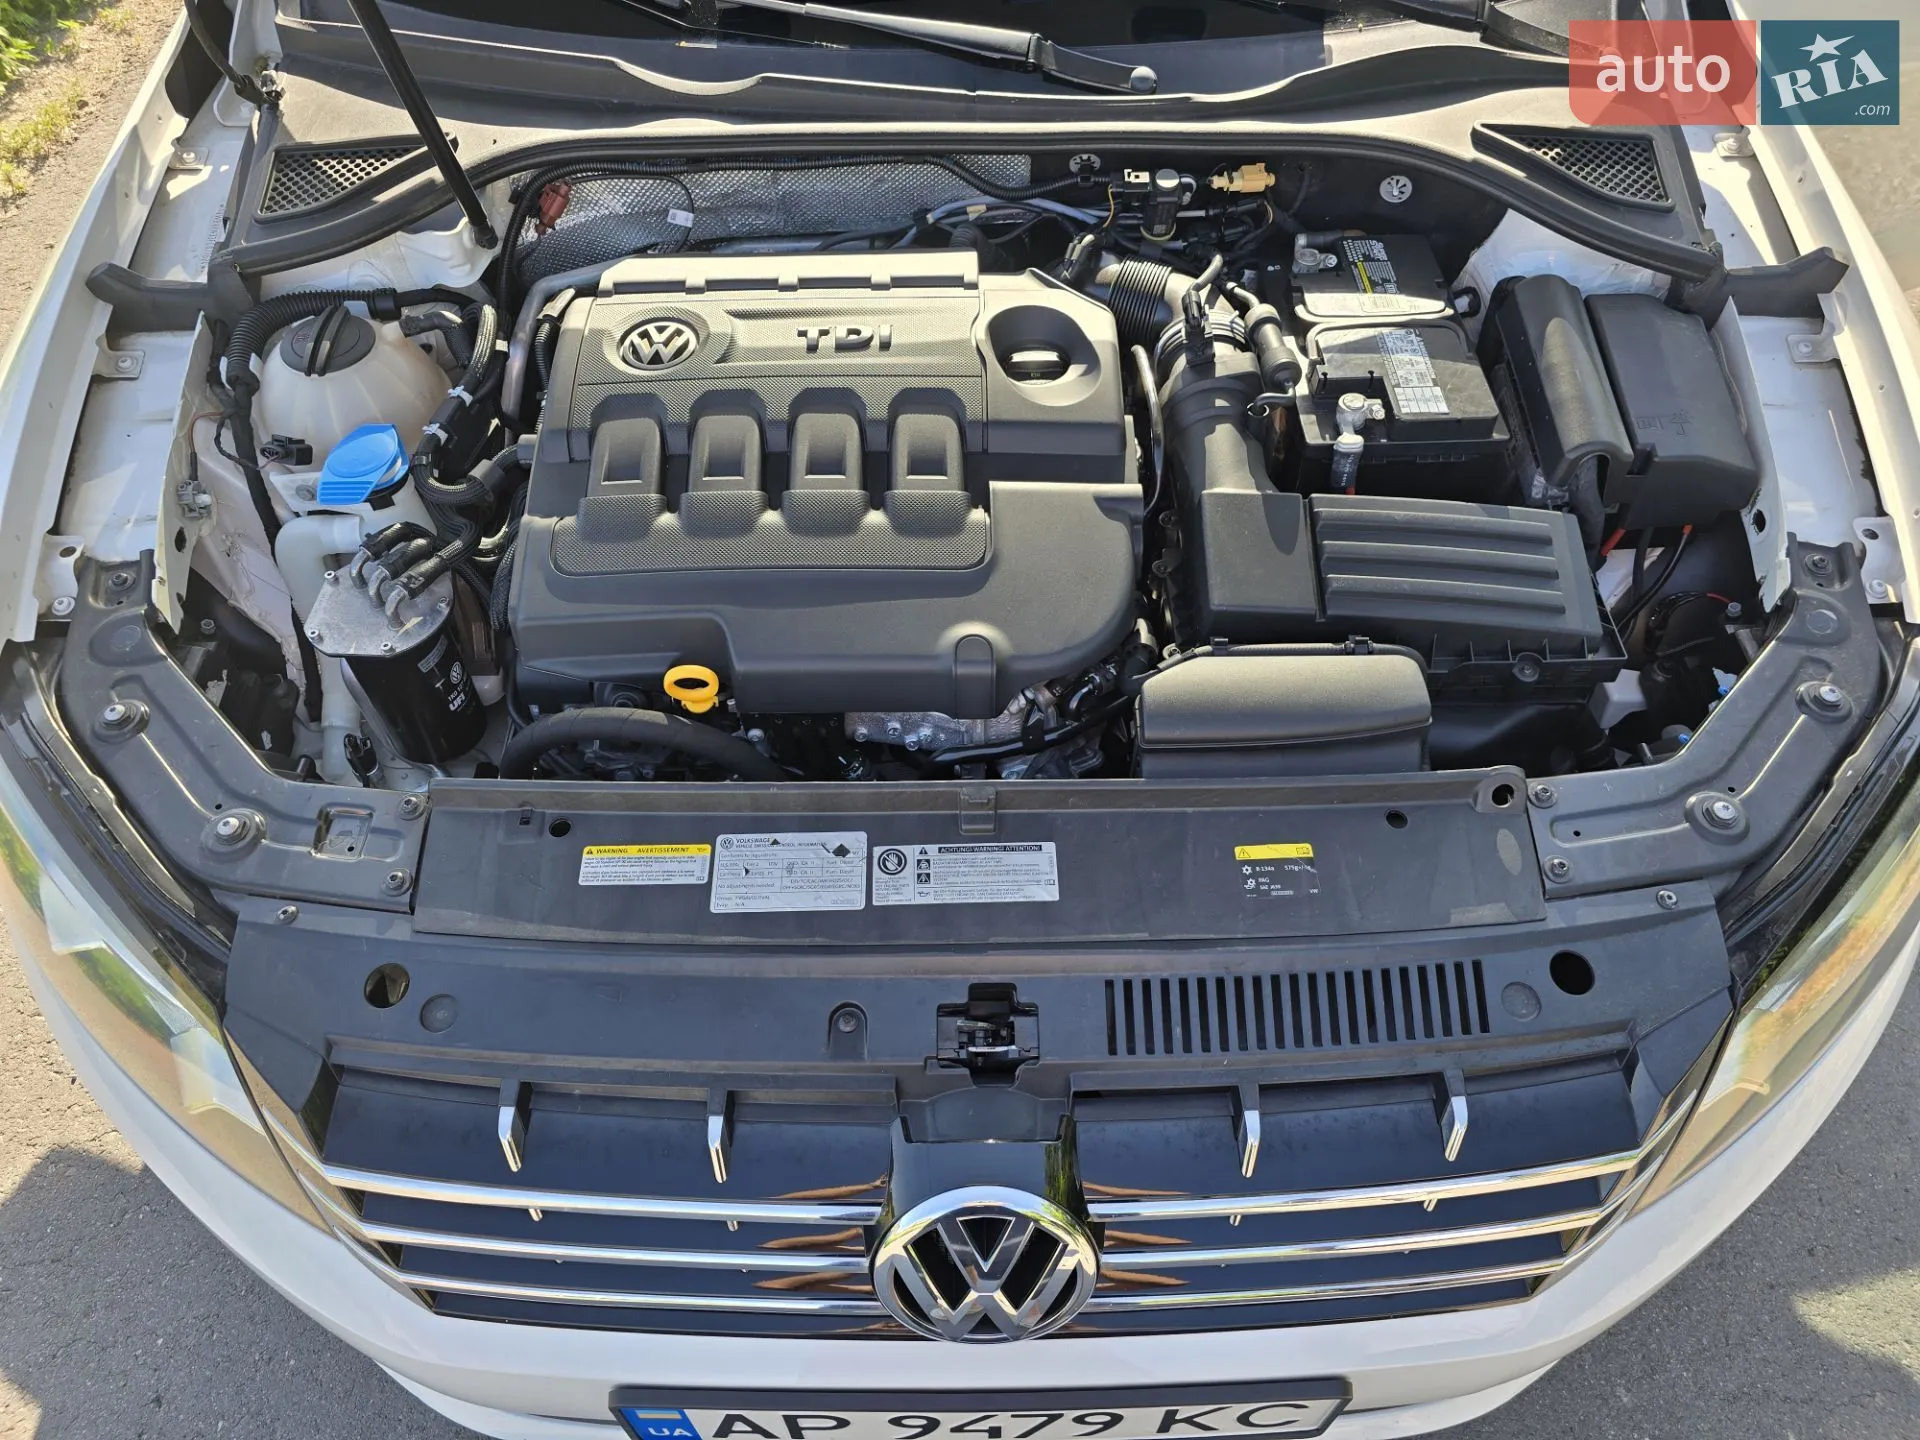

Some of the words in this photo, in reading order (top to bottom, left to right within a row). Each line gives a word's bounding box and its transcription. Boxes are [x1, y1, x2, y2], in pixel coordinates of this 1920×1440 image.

[797, 324, 893, 353] TDI
[648, 1427, 693, 1437] UA
[712, 1413, 852, 1440] AP
[887, 1412, 1125, 1440] 9479
[1156, 1403, 1310, 1434] KC
